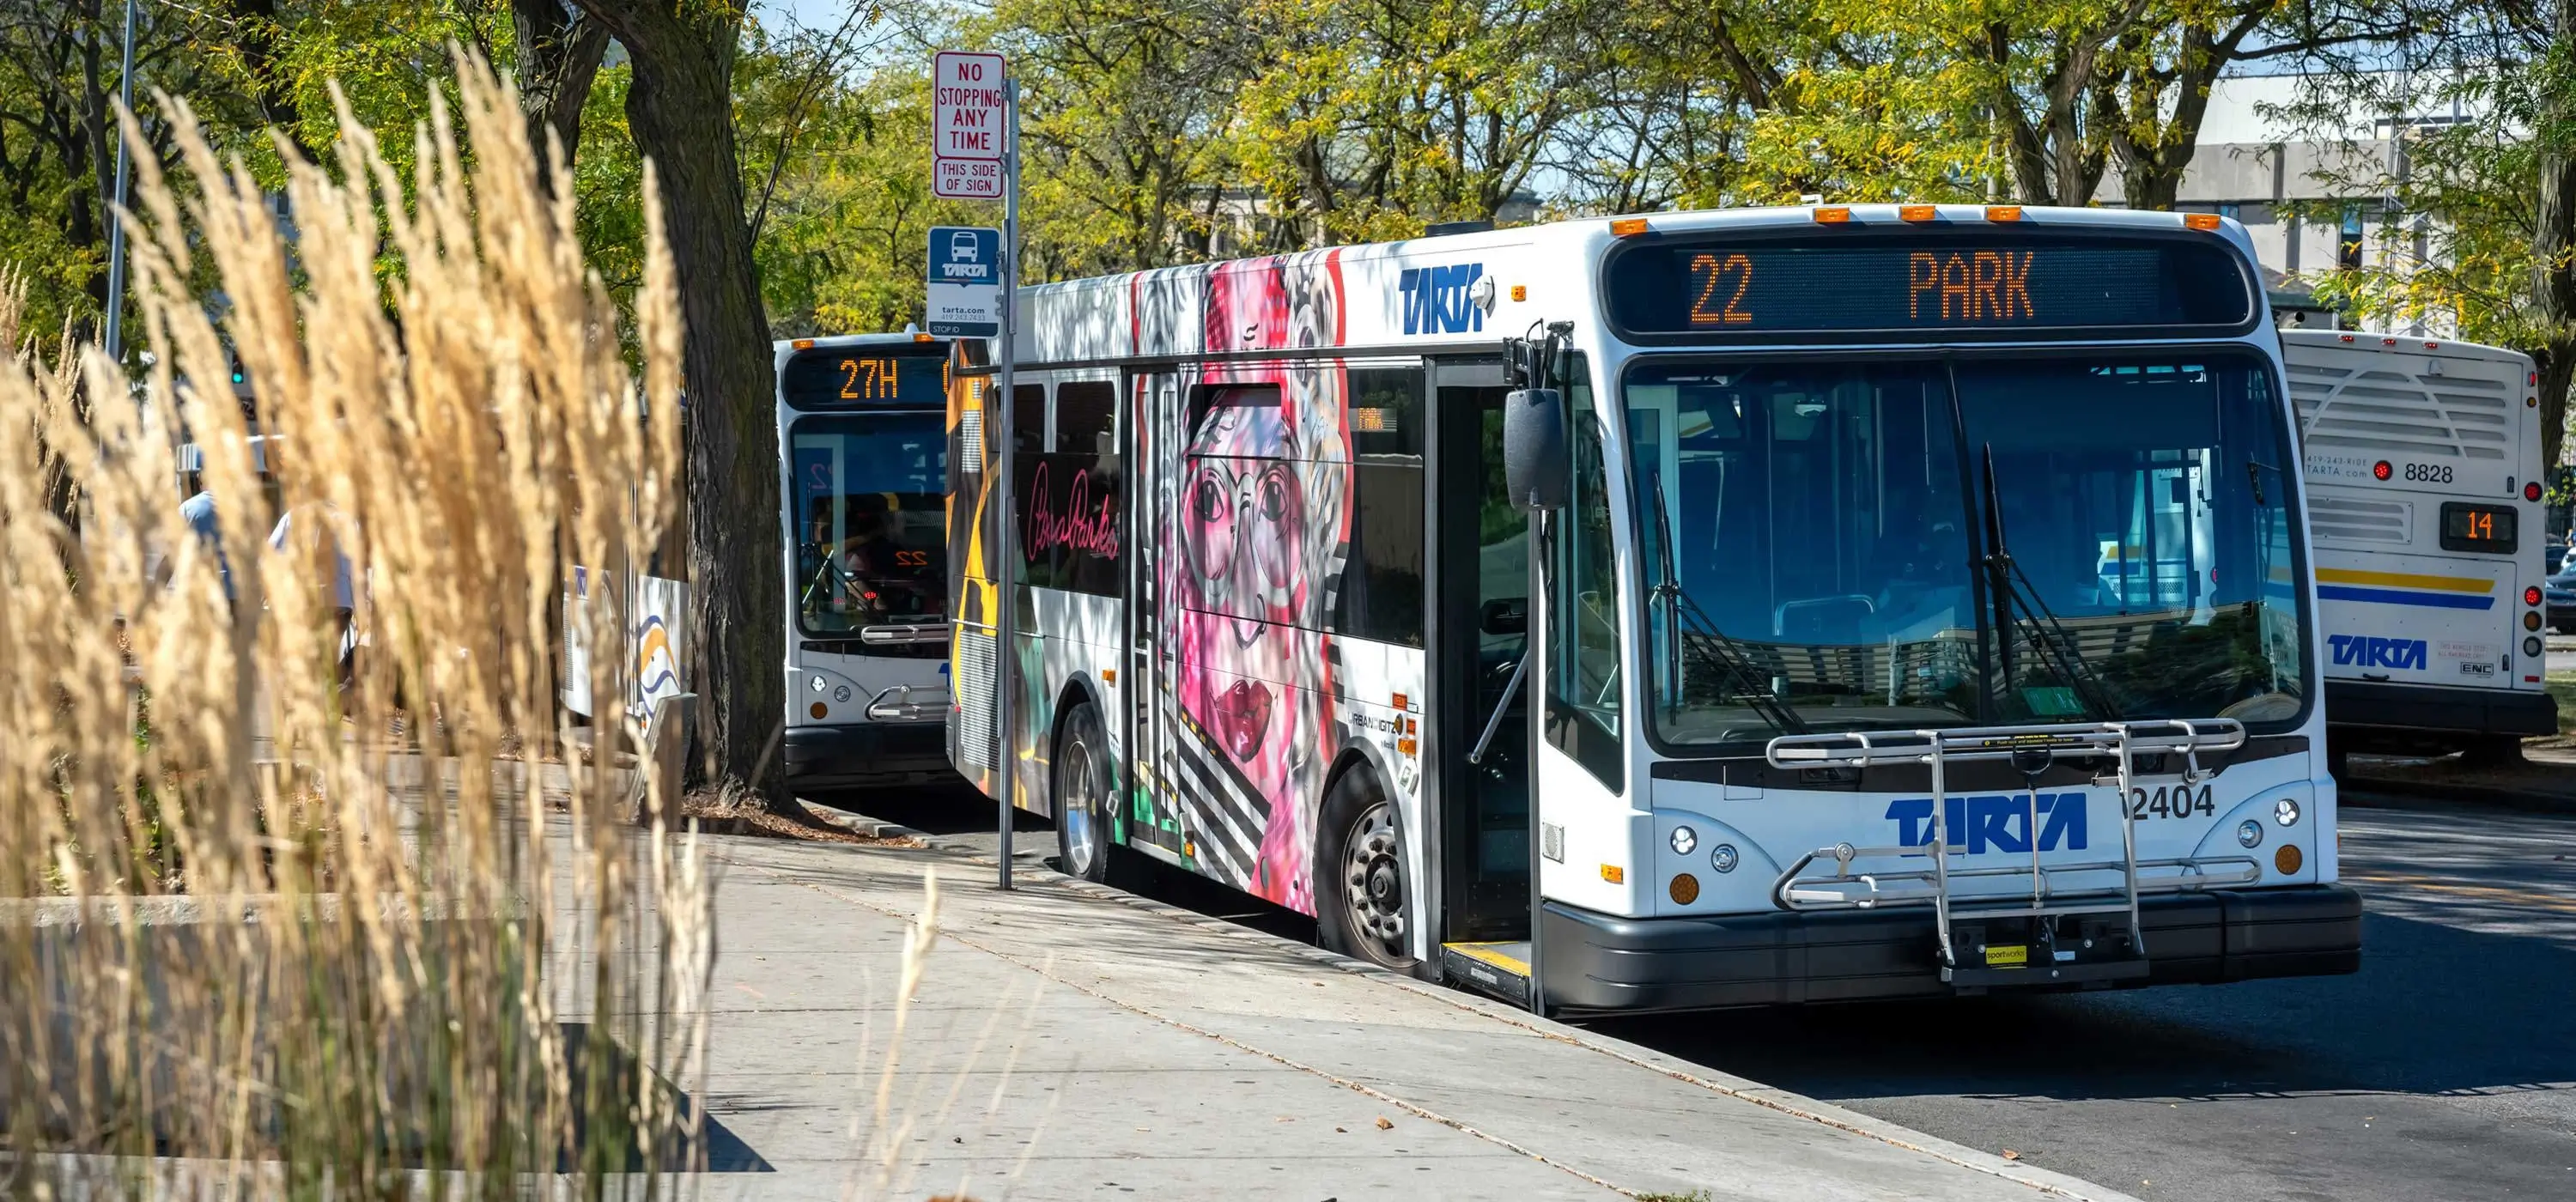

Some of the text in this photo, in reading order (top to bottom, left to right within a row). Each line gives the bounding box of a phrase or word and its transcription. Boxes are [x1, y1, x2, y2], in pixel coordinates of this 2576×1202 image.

[958, 63, 982, 82] NO
[939, 88, 1000, 107] STOPPING
[953, 108, 987, 127] ANY
[950, 131, 991, 150] TIME
[941, 163, 997, 177] THIS SIDE
[946, 179, 992, 191] OF SIGN
[942, 263, 987, 277] TARTA
[1691, 252, 2033, 322] 22 PARK
[1399, 263, 1483, 335] TARTA
[840, 359, 897, 398] 27H
[2405, 463, 2453, 483] 8828
[2468, 511, 2493, 539] 14
[2327, 634, 2427, 671] TARTA
[2131, 784, 2215, 821] 2404
[1885, 792, 2087, 858] TARTA
